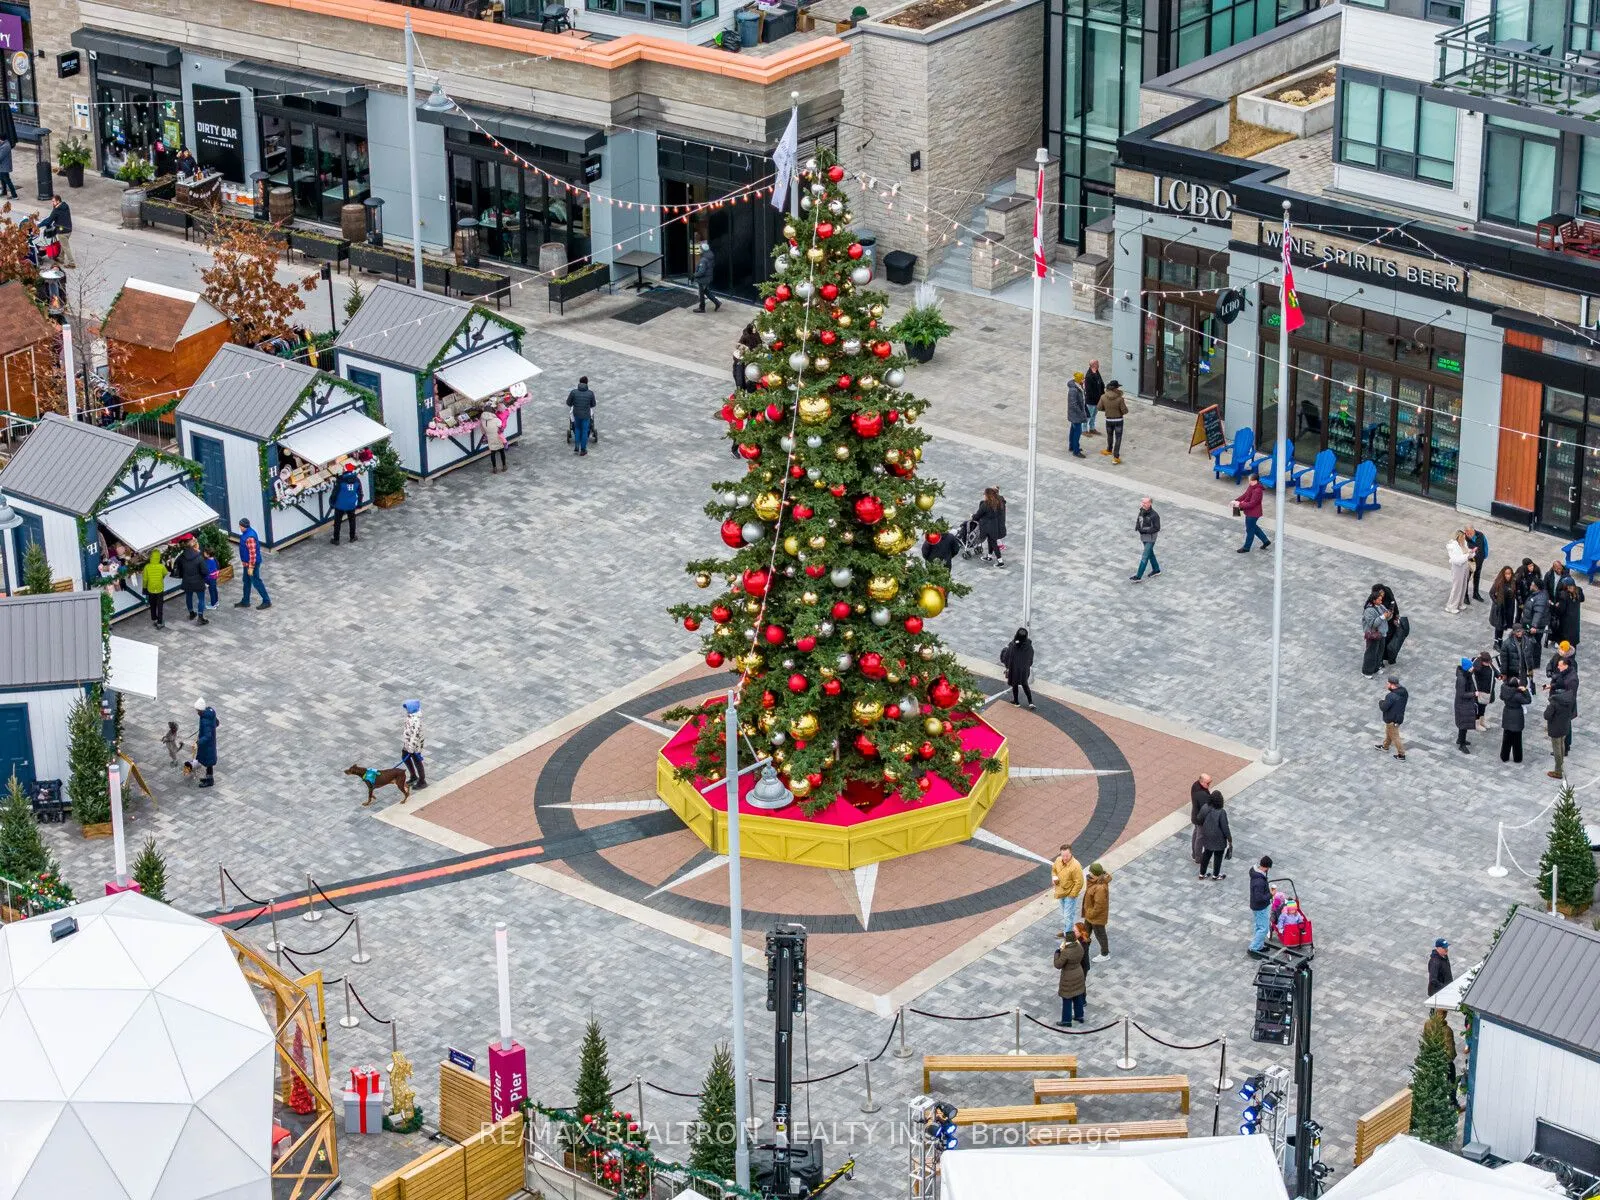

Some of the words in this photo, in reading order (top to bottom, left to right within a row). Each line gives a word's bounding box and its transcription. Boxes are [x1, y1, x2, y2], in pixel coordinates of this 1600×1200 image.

[197, 121, 219, 135] DIRTY
[221, 126, 237, 139] OAR
[1153, 176, 1232, 220] LCBO
[1266, 230, 1315, 257] WNE
[1323, 246, 1397, 277] SPIRITS
[1407, 267, 1459, 293] BEER
[1221, 298, 1240, 316] LCBO
[493, 1070, 503, 1101] Pier
[509, 1072, 522, 1102] Pier
